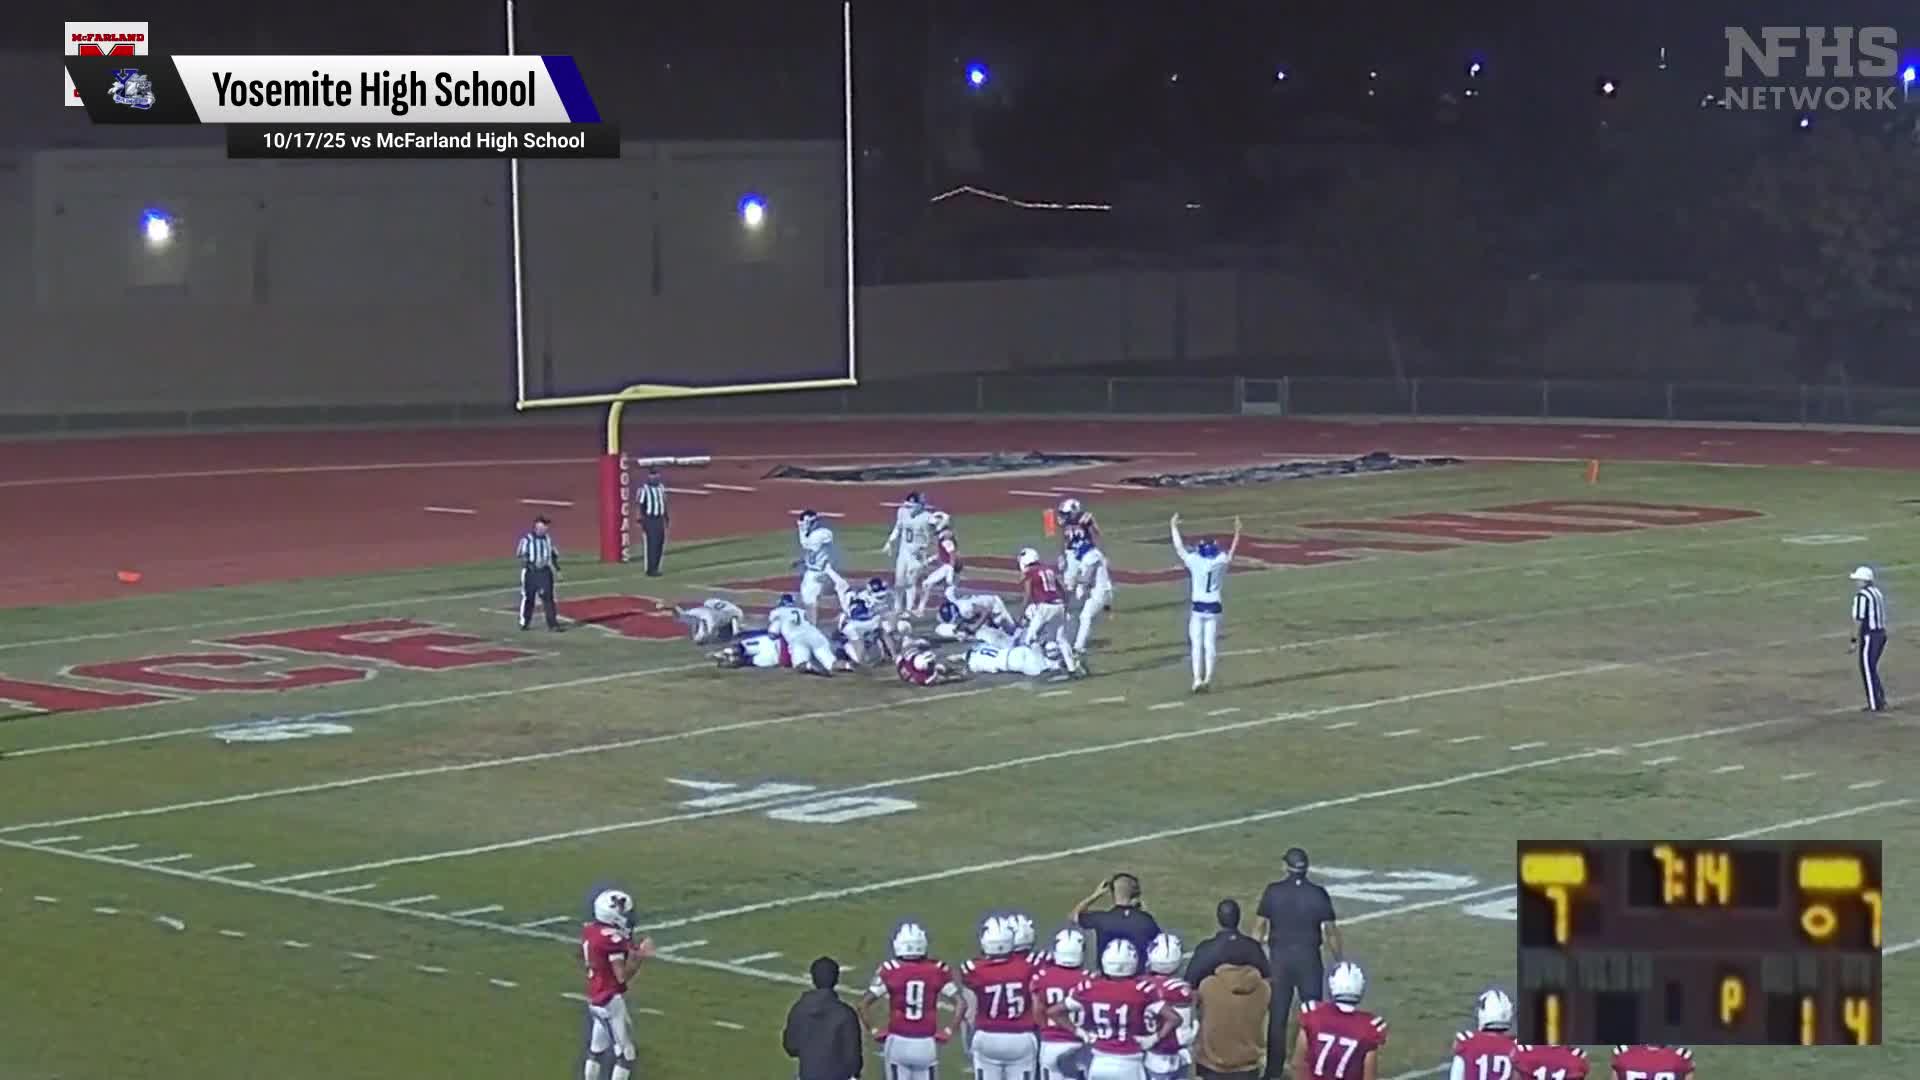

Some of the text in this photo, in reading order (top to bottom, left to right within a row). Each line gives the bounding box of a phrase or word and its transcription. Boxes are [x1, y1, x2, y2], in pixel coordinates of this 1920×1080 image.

[619, 454, 631, 562] COUGARS
[905, 980, 925, 1020] 9
[984, 982, 1024, 1019] 75
[1092, 1002, 1129, 1041] 51
[1314, 1032, 1358, 1078] 77
